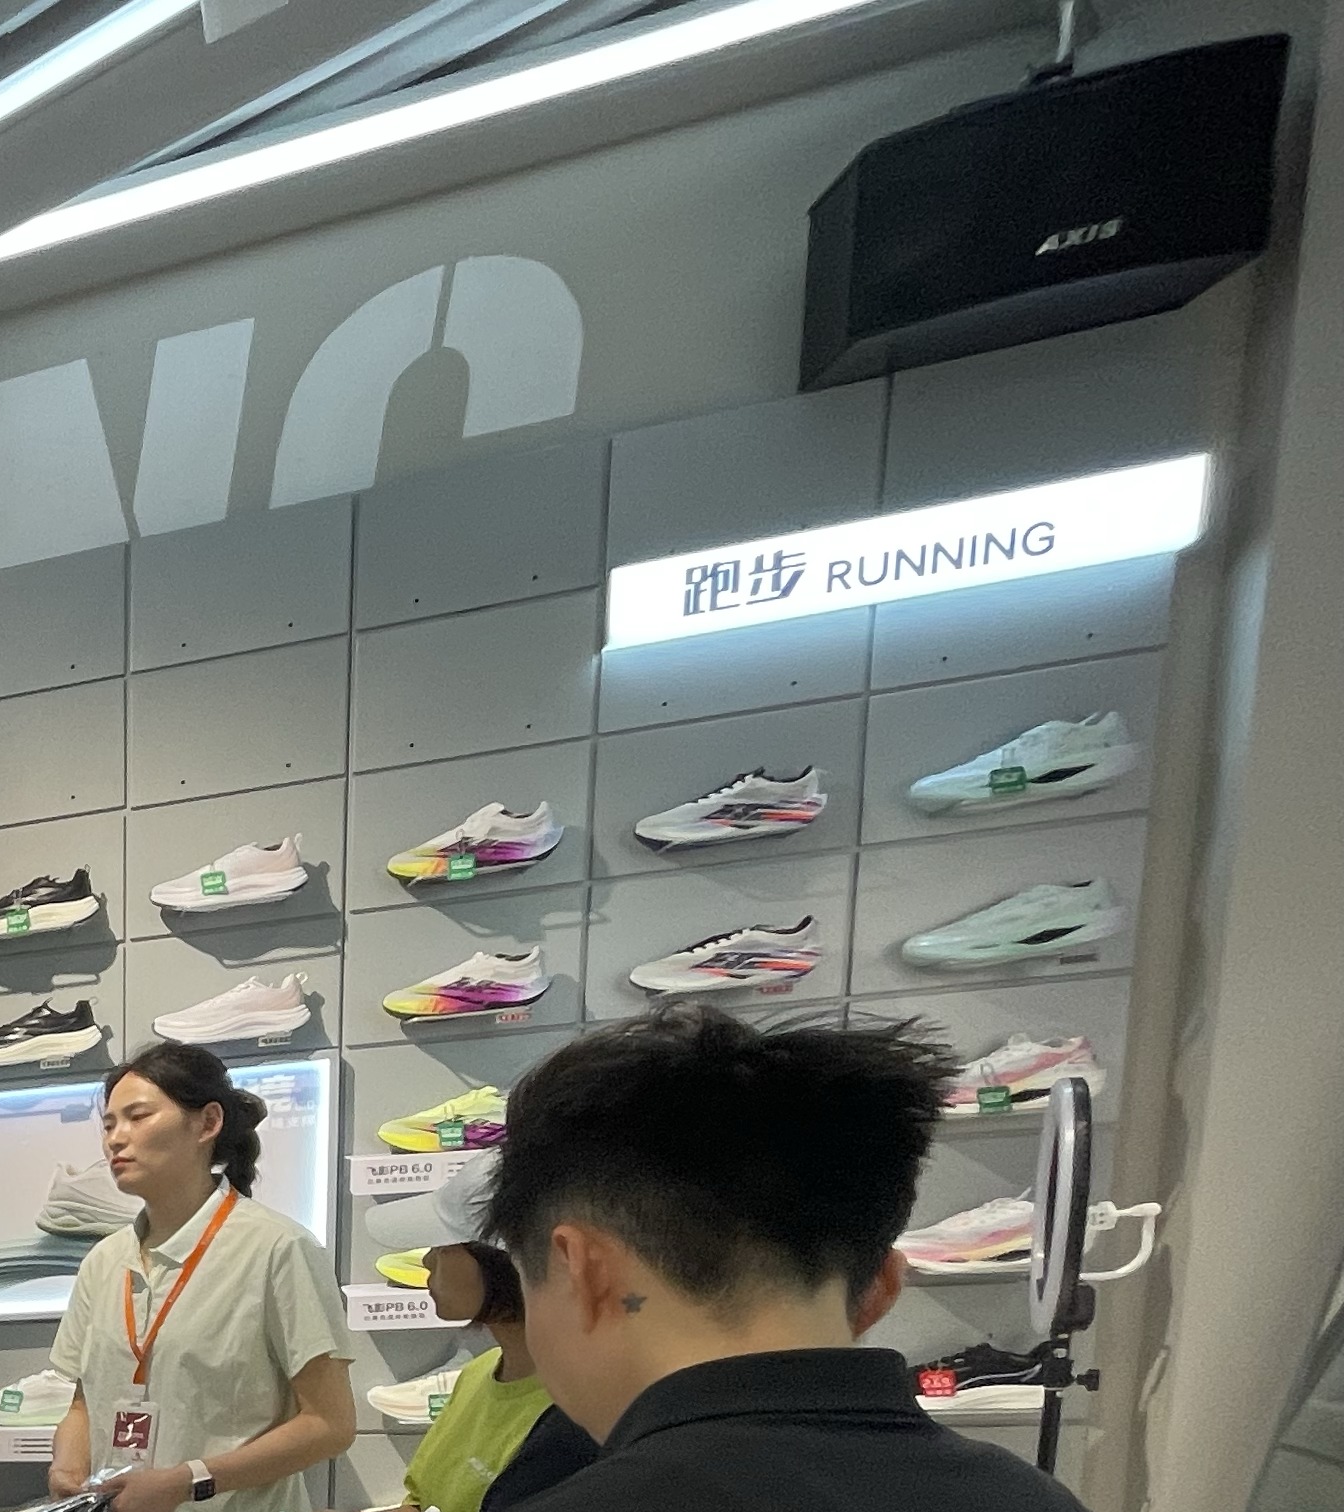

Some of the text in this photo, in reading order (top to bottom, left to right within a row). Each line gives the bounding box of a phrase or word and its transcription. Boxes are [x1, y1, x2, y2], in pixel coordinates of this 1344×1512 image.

[1035, 217, 1121, 255] AXIS
[683, 521, 1056, 617] 跑步 RUNNING
[411, 1162, 432, 1174] 6.0
